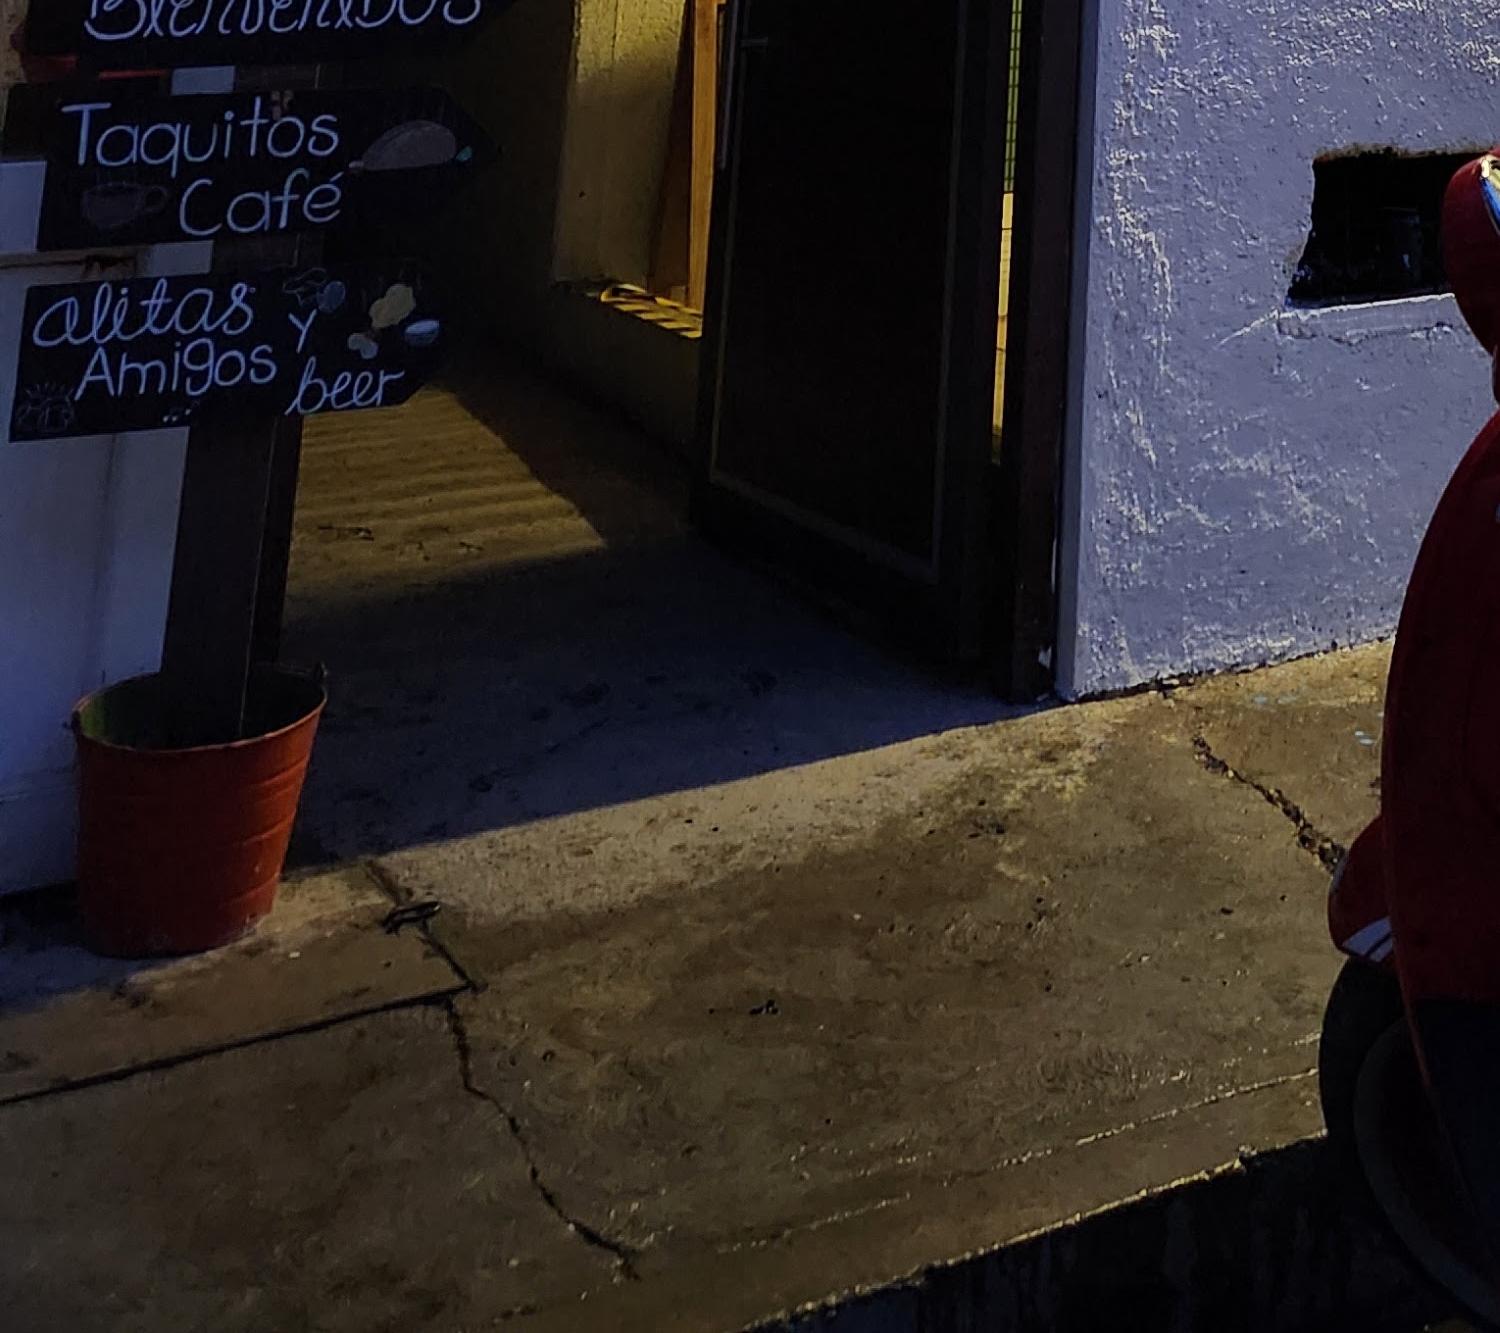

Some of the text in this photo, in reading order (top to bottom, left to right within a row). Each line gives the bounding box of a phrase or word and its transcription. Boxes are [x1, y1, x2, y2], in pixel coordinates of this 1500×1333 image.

[61, 95, 340, 179] Taquitos
[178, 167, 347, 236] Café
[32, 277, 256, 347] alitas
[73, 337, 405, 416] Amigos beer
